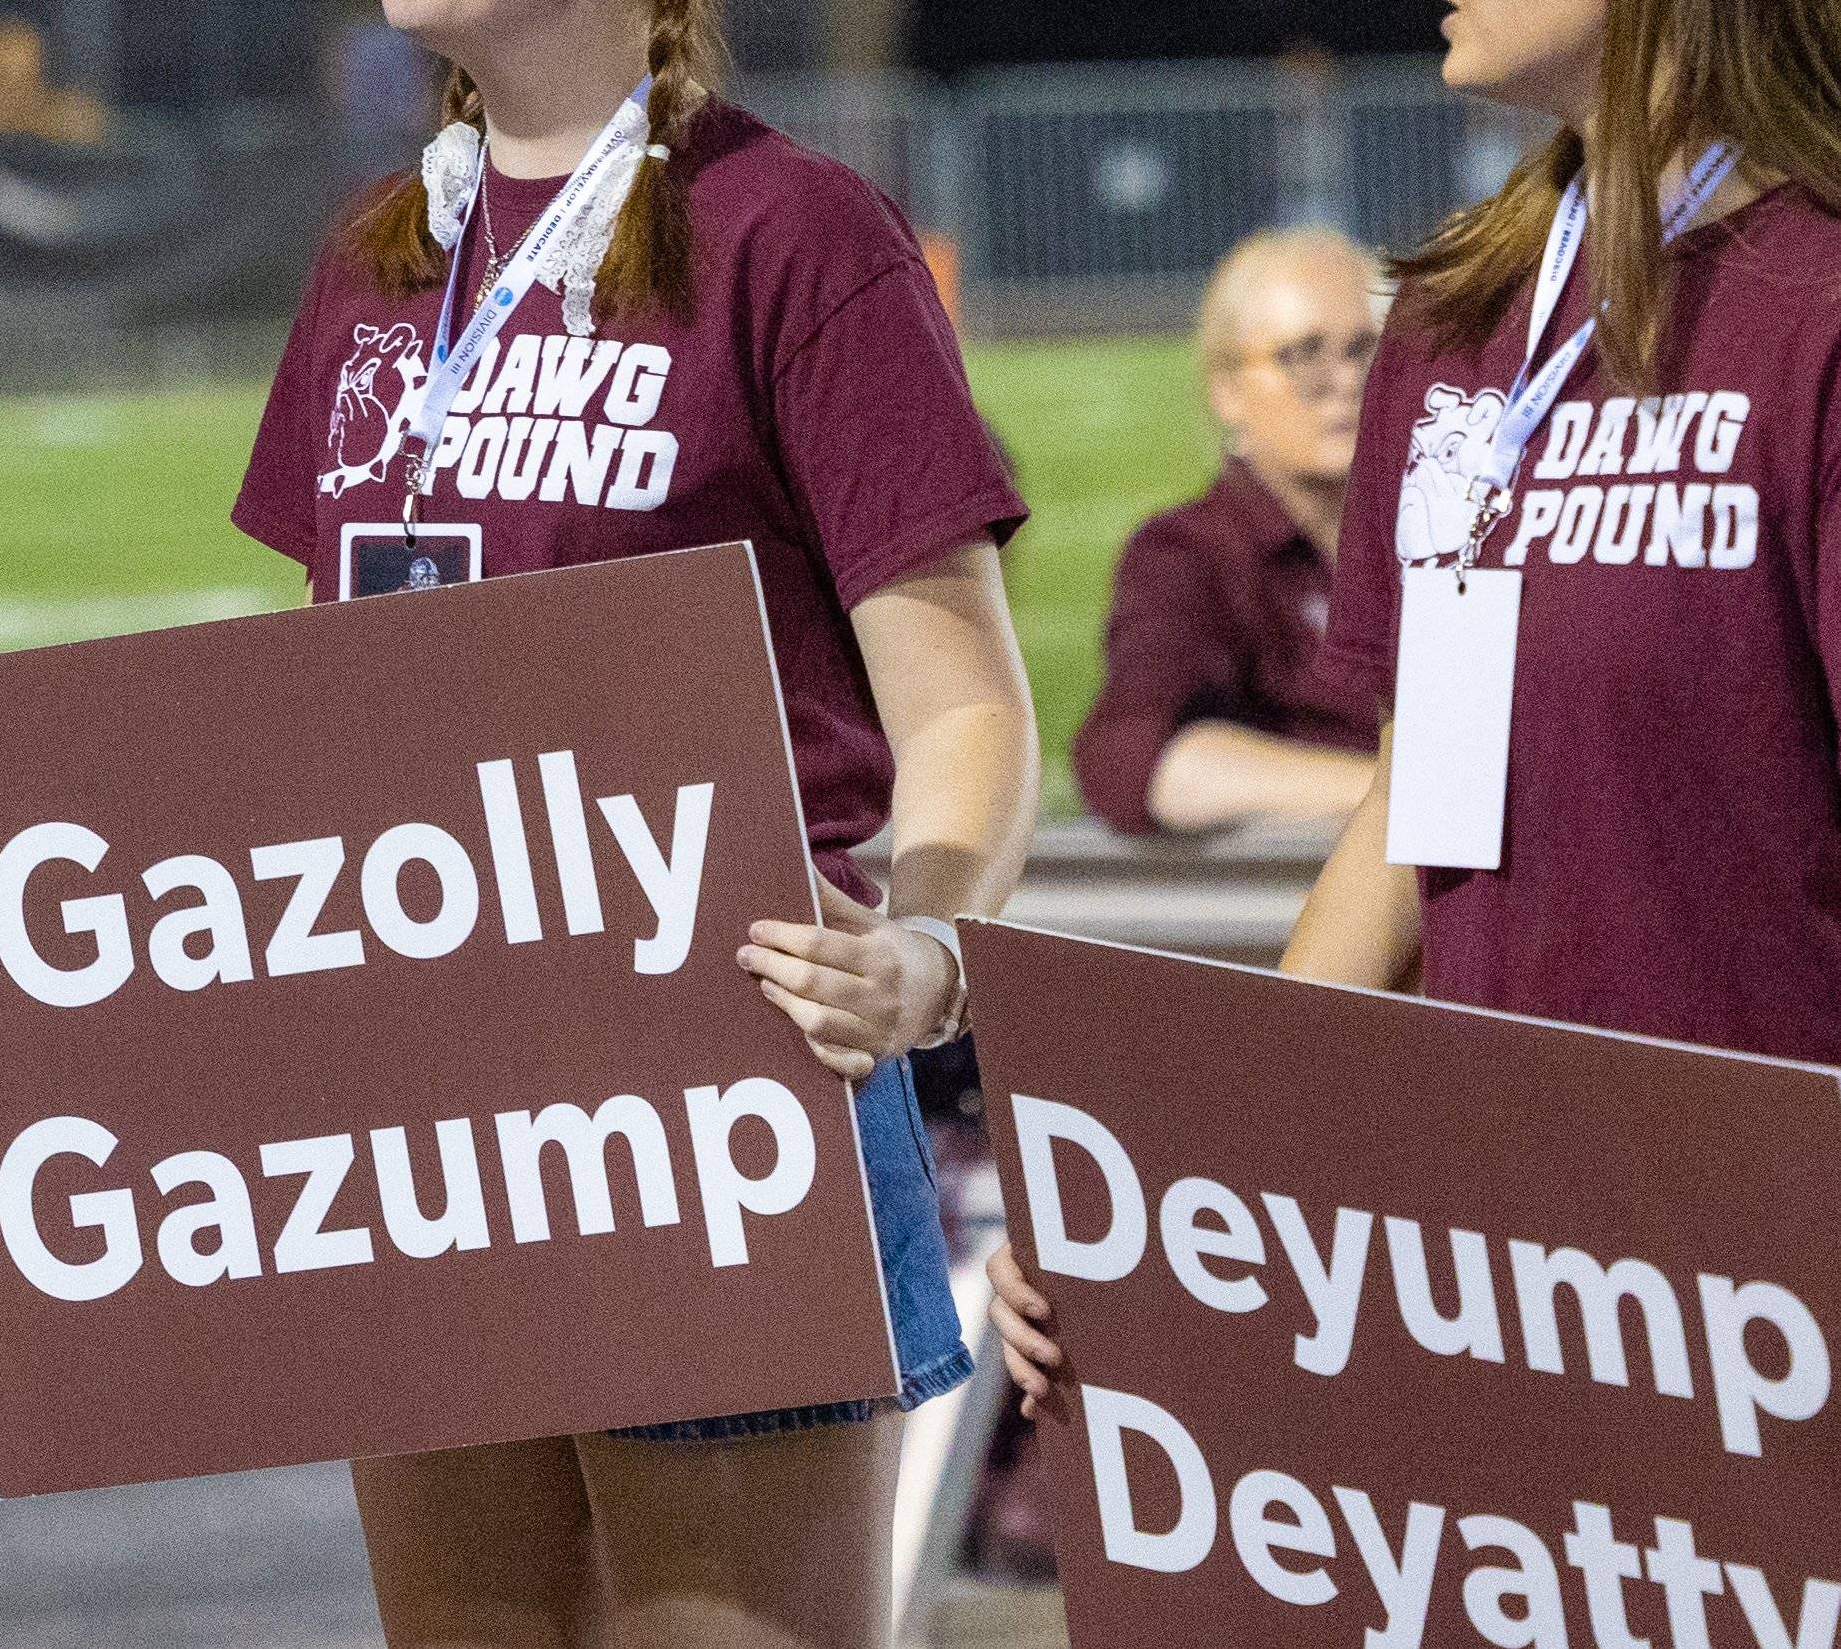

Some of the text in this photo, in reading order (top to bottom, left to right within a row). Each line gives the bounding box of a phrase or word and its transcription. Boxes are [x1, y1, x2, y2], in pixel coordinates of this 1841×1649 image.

[526, 214, 562, 262] DEDICATE
[450, 309, 497, 375] DIVISION III
[421, 415, 680, 512] POUND
[1534, 390, 1751, 480] DAWG
[1504, 482, 1759, 570] POUND
[1012, 1095, 1829, 1455] Deyump
